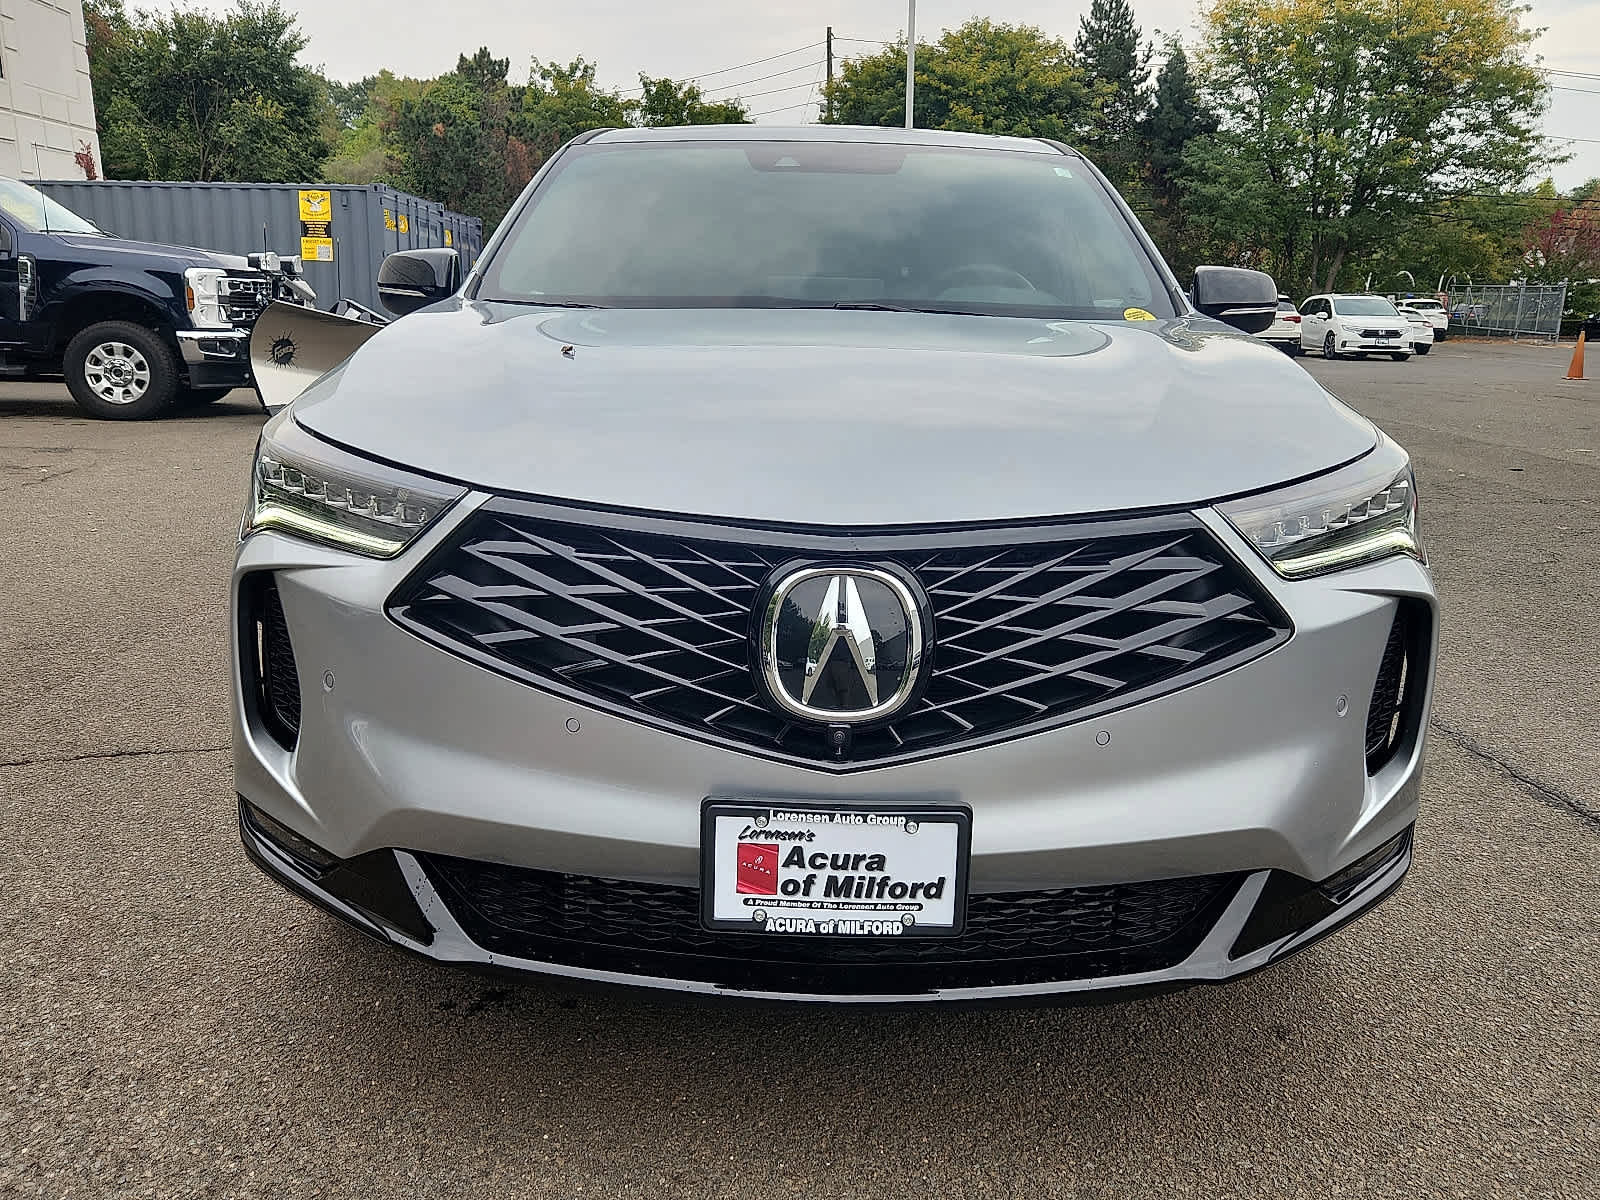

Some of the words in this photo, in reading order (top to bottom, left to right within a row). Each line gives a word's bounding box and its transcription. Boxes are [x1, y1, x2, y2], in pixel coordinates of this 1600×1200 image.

[770, 809, 830, 823] Lorensen
[833, 813, 863, 825] Auto
[867, 814, 906, 827] Group
[738, 825, 816, 842] Lorensen's
[782, 846, 887, 872] Acura
[741, 861, 771, 875] ACURA
[780, 873, 817, 897] of
[823, 875, 946, 899] Milford
[839, 902, 875, 910] Lorensen
[896, 903, 920, 911] Group
[765, 918, 816, 933] ACURA
[820, 919, 835, 934] of
[837, 920, 903, 935] MILFORD
